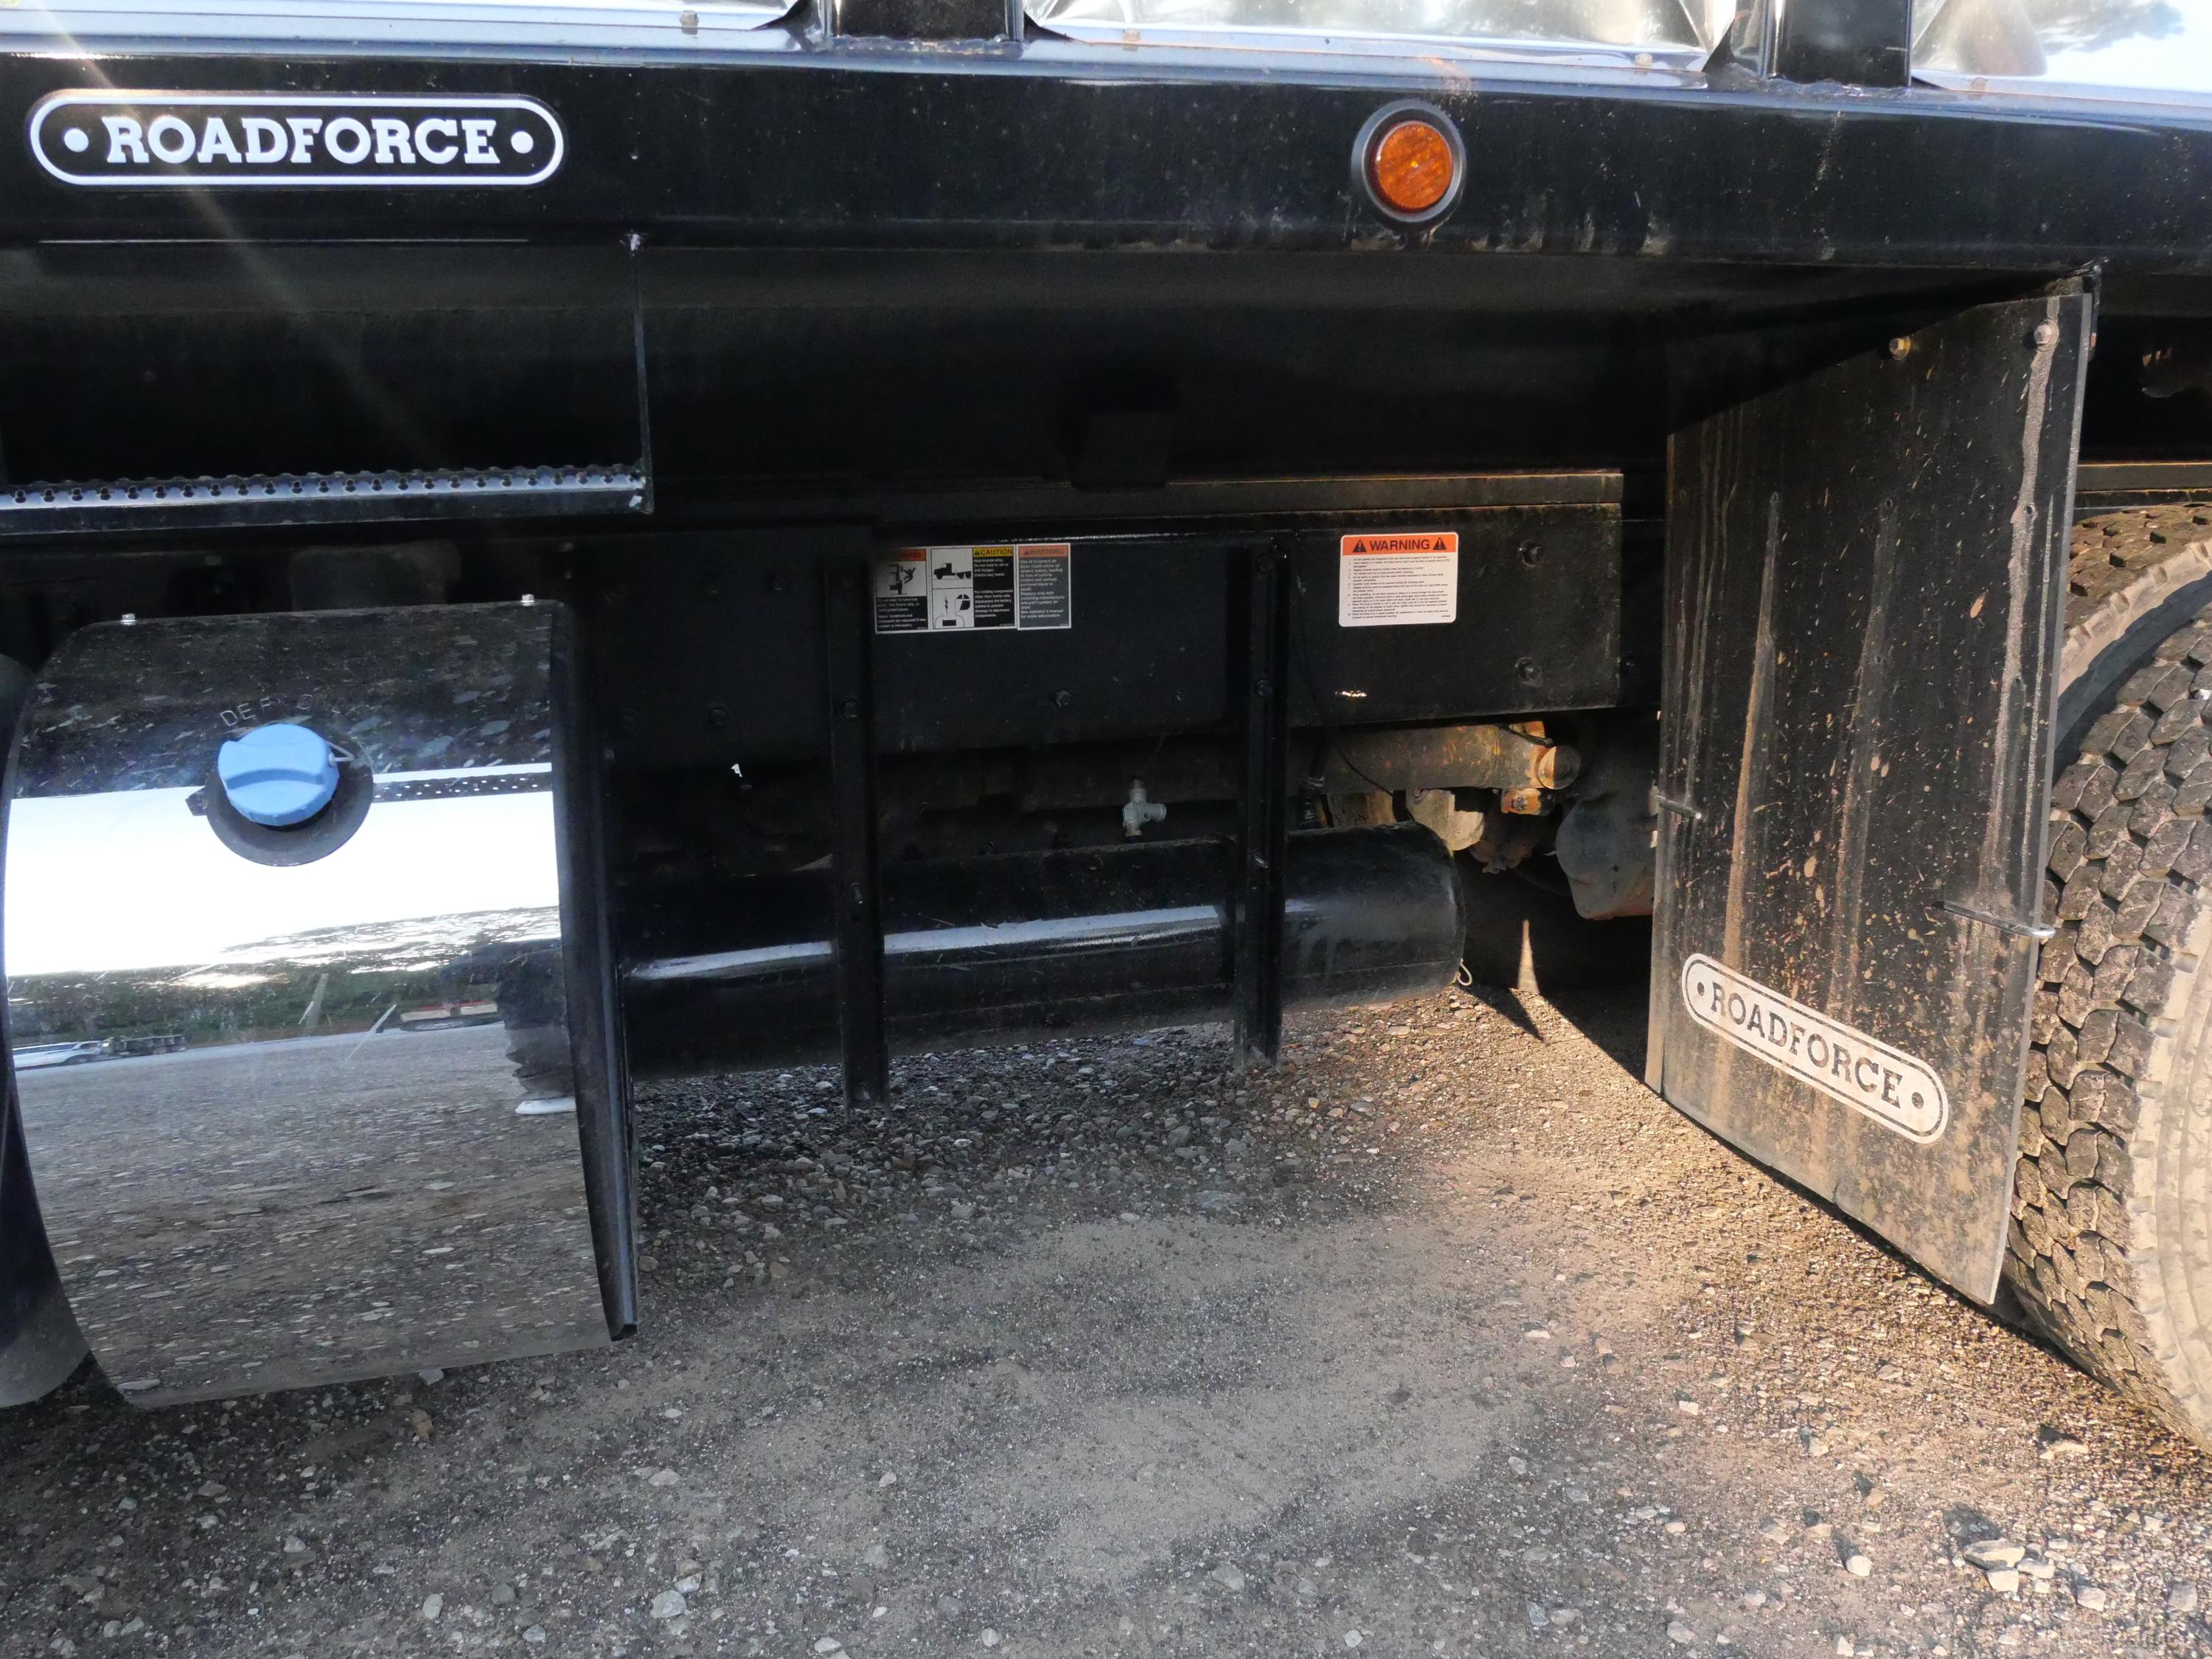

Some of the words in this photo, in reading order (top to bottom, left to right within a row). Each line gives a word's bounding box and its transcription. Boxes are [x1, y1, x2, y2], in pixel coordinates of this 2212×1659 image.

[102, 114, 500, 164] ROADFORCE
[1369, 539, 1430, 552] WARNING
[220, 696, 271, 726] DEF
[1711, 981, 1902, 1109] ROADFORCE
